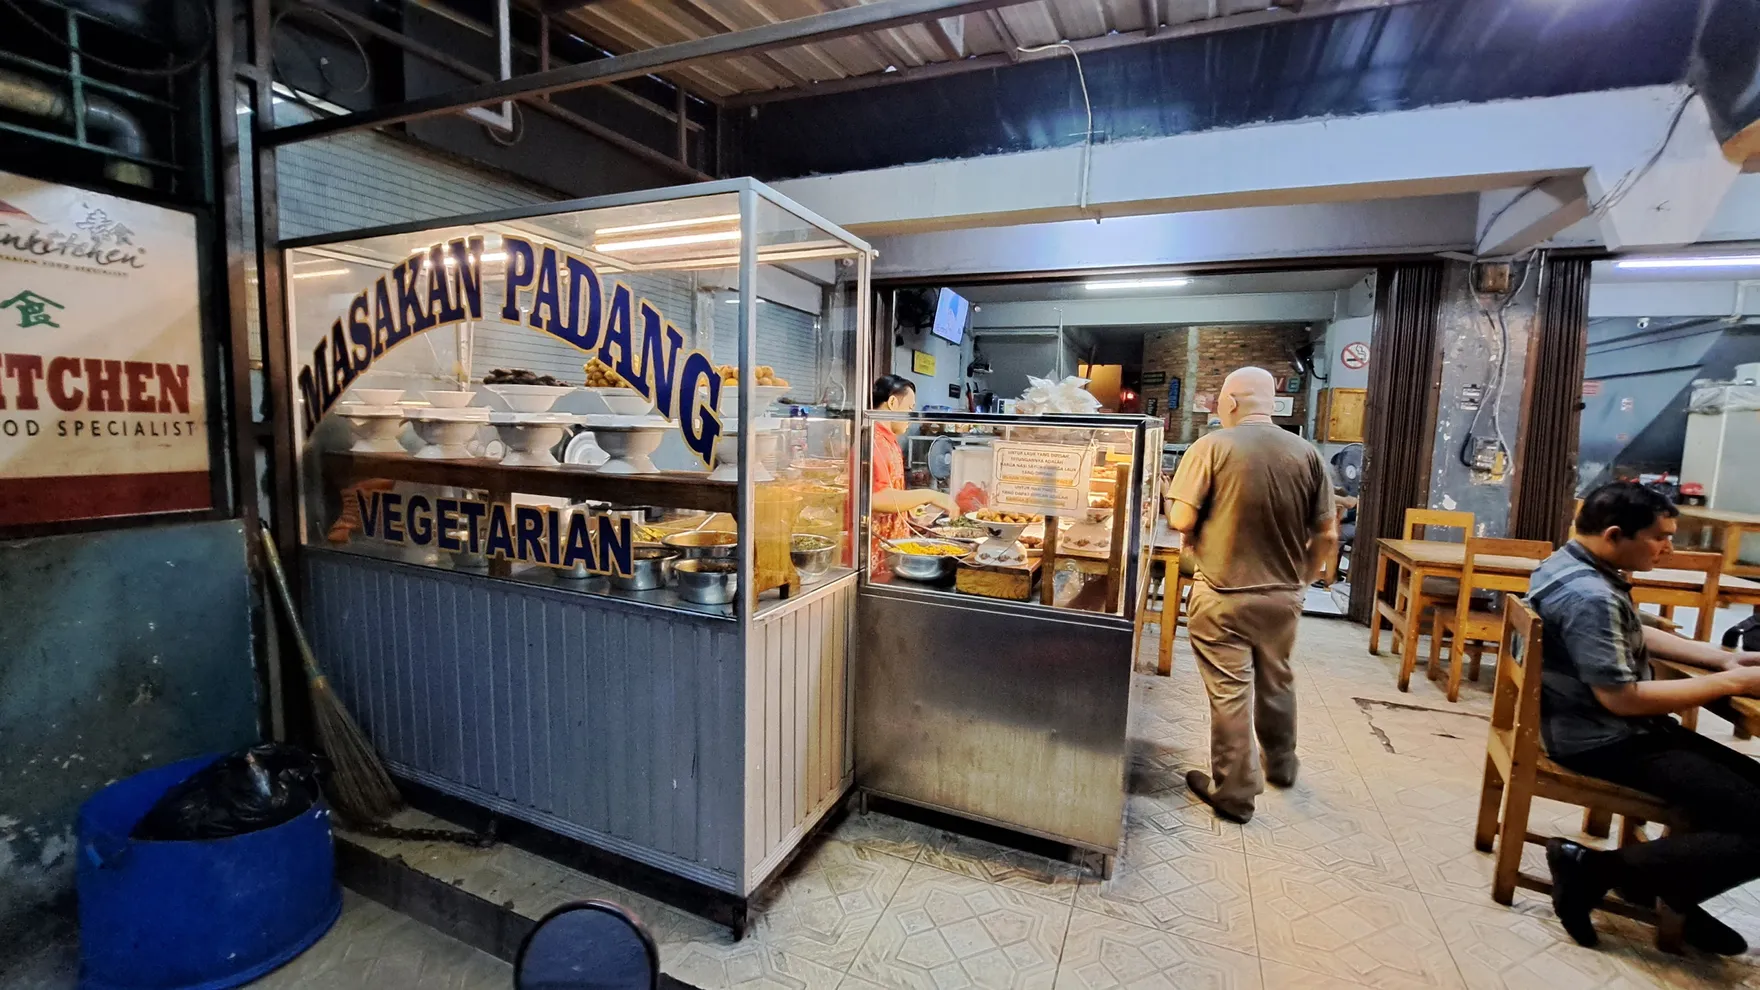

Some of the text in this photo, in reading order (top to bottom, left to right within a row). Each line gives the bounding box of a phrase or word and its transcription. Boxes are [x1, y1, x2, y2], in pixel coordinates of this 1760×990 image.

[0, 353, 190, 414] TCHEN
[298, 234, 724, 471] MASAKAN PADANG
[57, 420, 195, 437] SPECIALIST
[357, 489, 634, 577] VEGETARIAN
